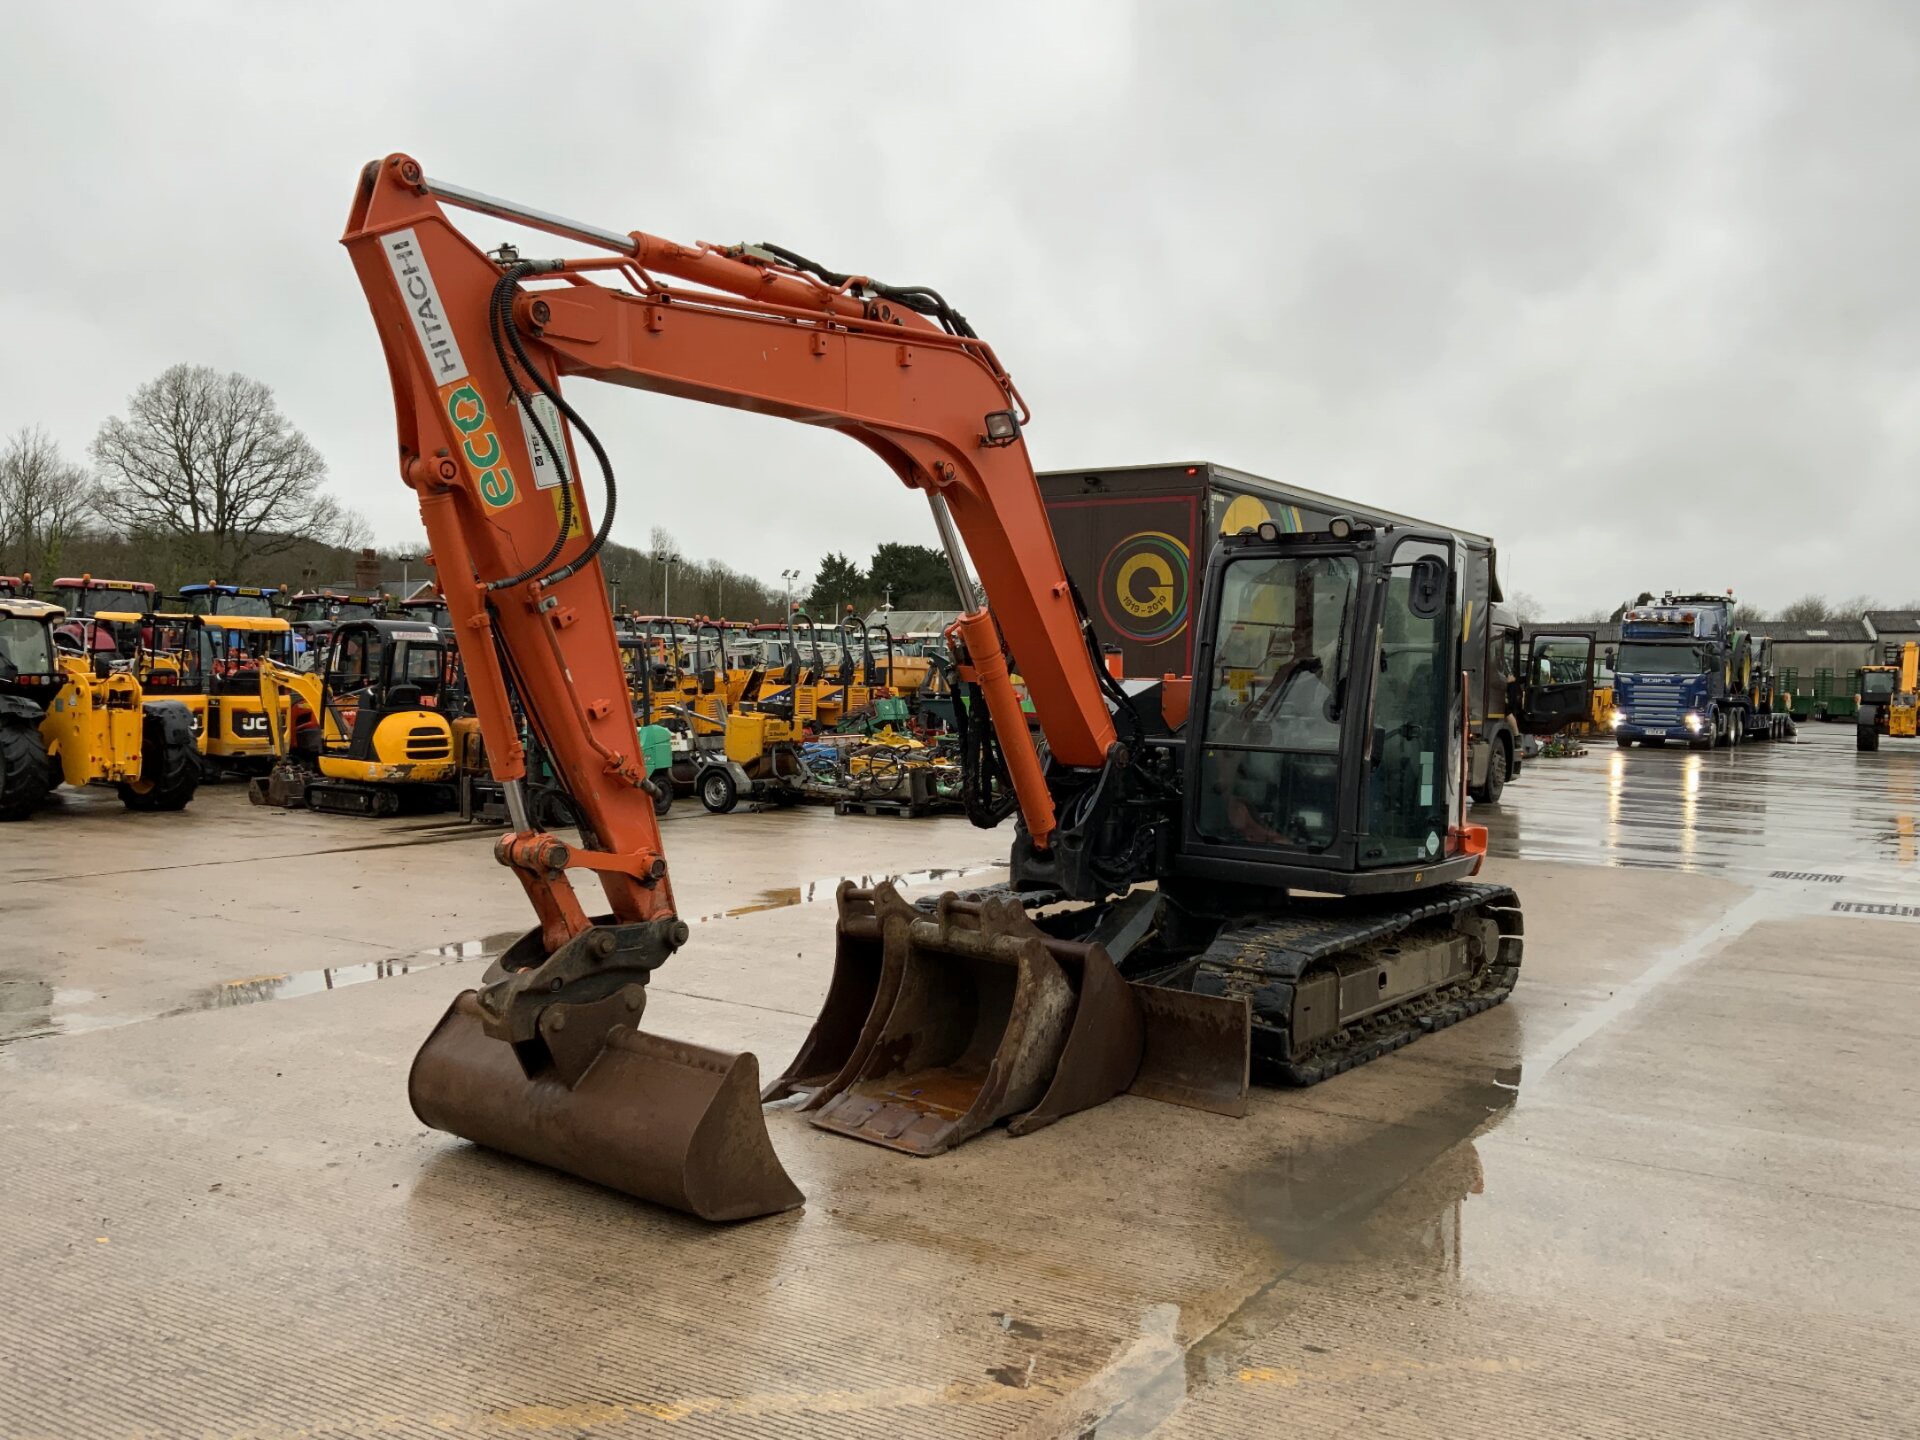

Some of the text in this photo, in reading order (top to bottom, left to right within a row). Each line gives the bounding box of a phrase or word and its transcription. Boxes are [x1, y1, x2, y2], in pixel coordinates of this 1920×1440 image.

[392, 240, 457, 377] HITACHI
[447, 382, 516, 507] eco
[242, 717, 268, 730] JC
